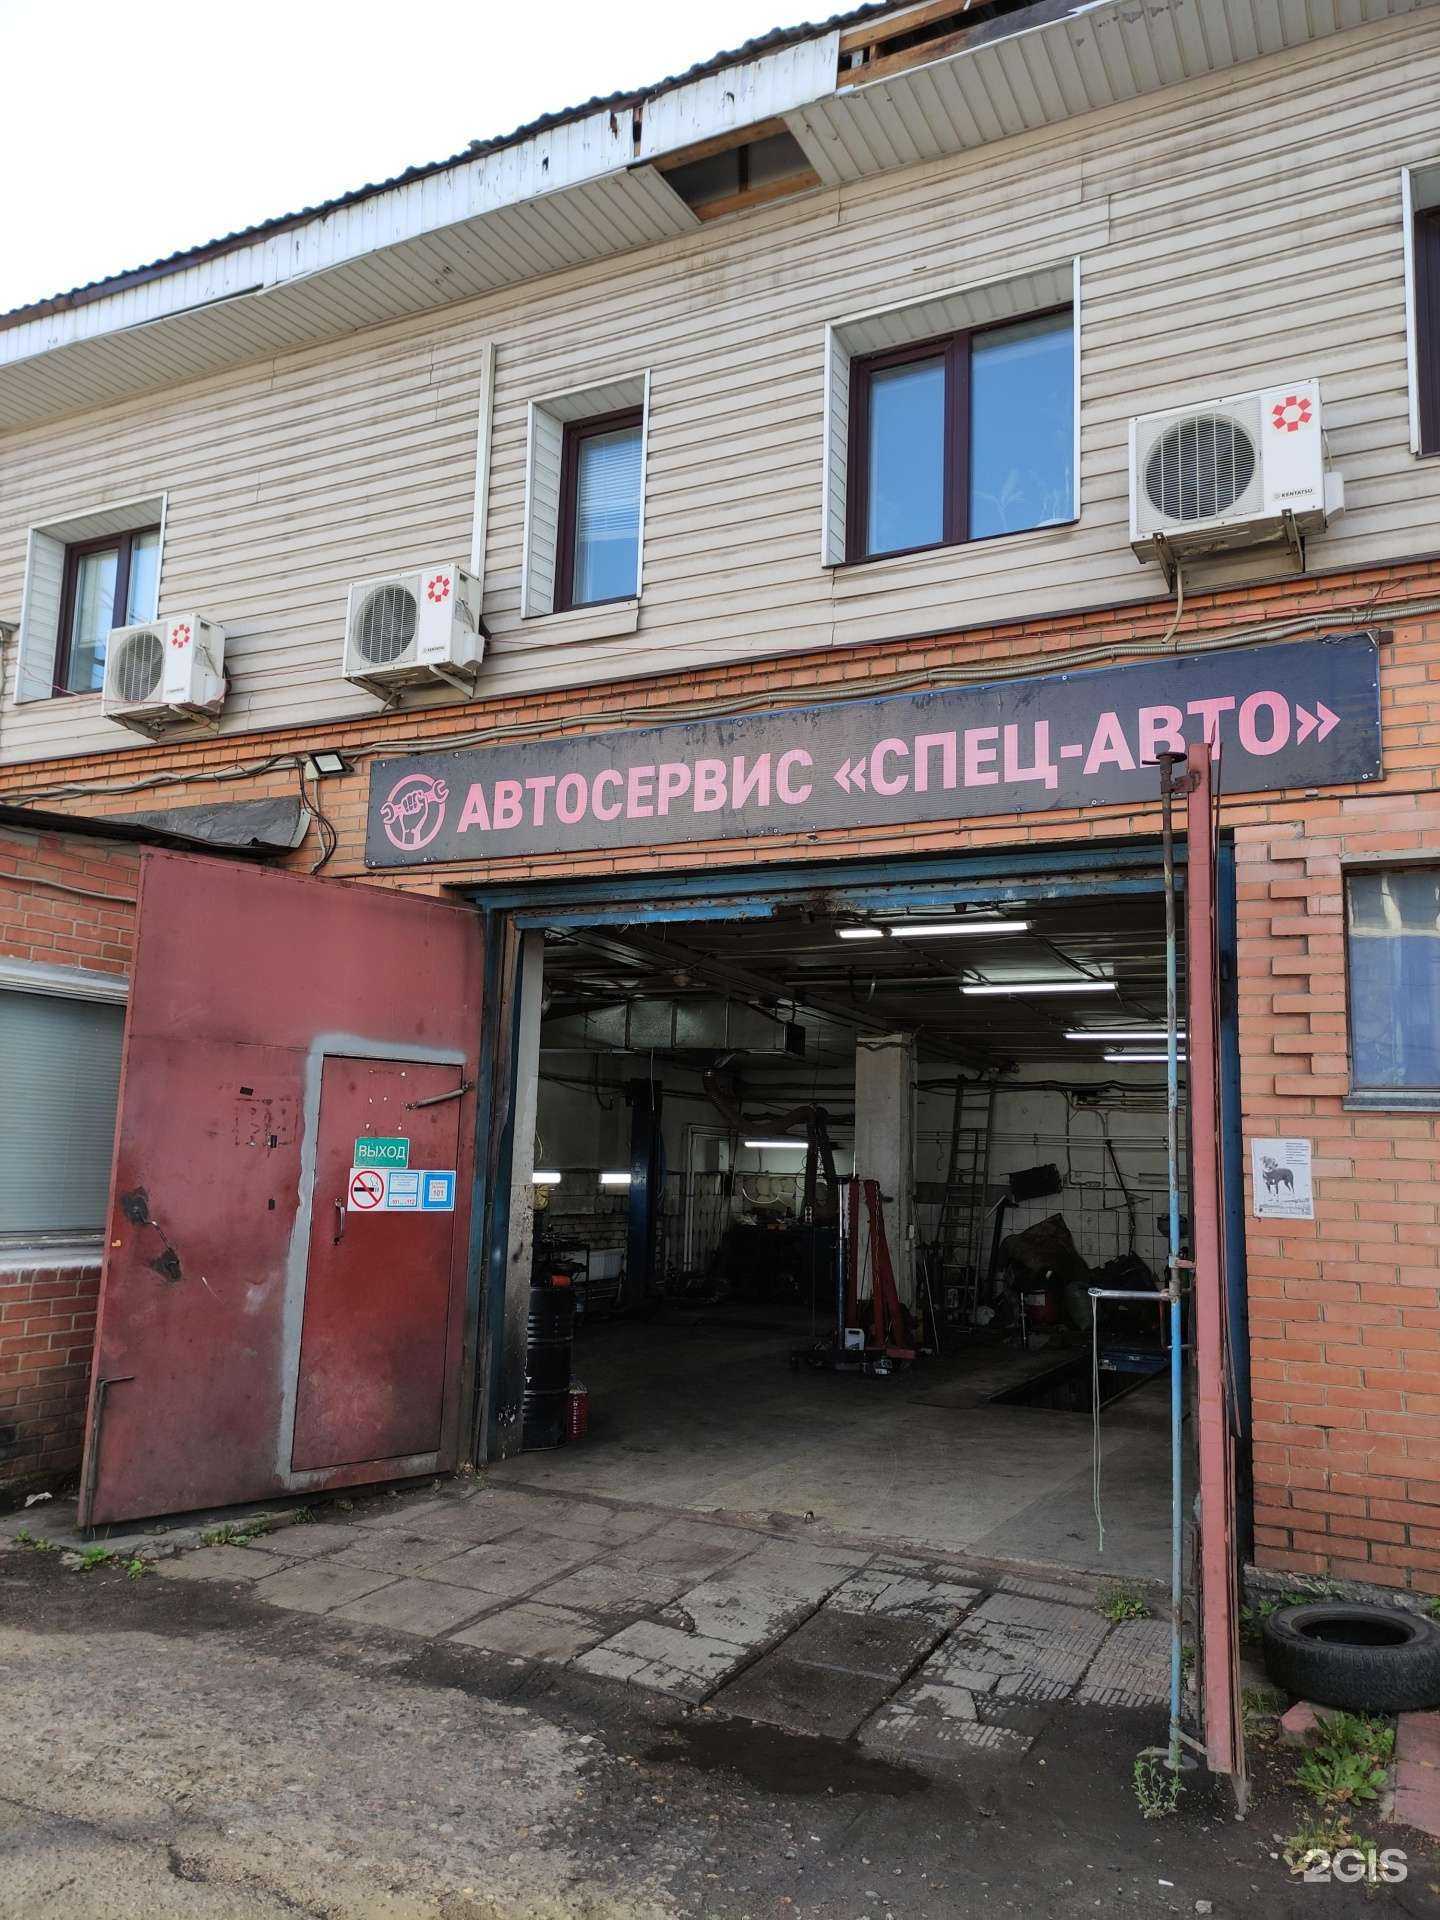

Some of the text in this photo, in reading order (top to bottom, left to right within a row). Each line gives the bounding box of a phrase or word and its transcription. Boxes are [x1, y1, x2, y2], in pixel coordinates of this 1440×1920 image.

[1281, 488, 1313, 498] KENTATSU
[456, 690, 1342, 834] АВТОСЕРВИС «СПЕЦ-АВТО»
[359, 1145, 406, 1160] ВЫХОД
